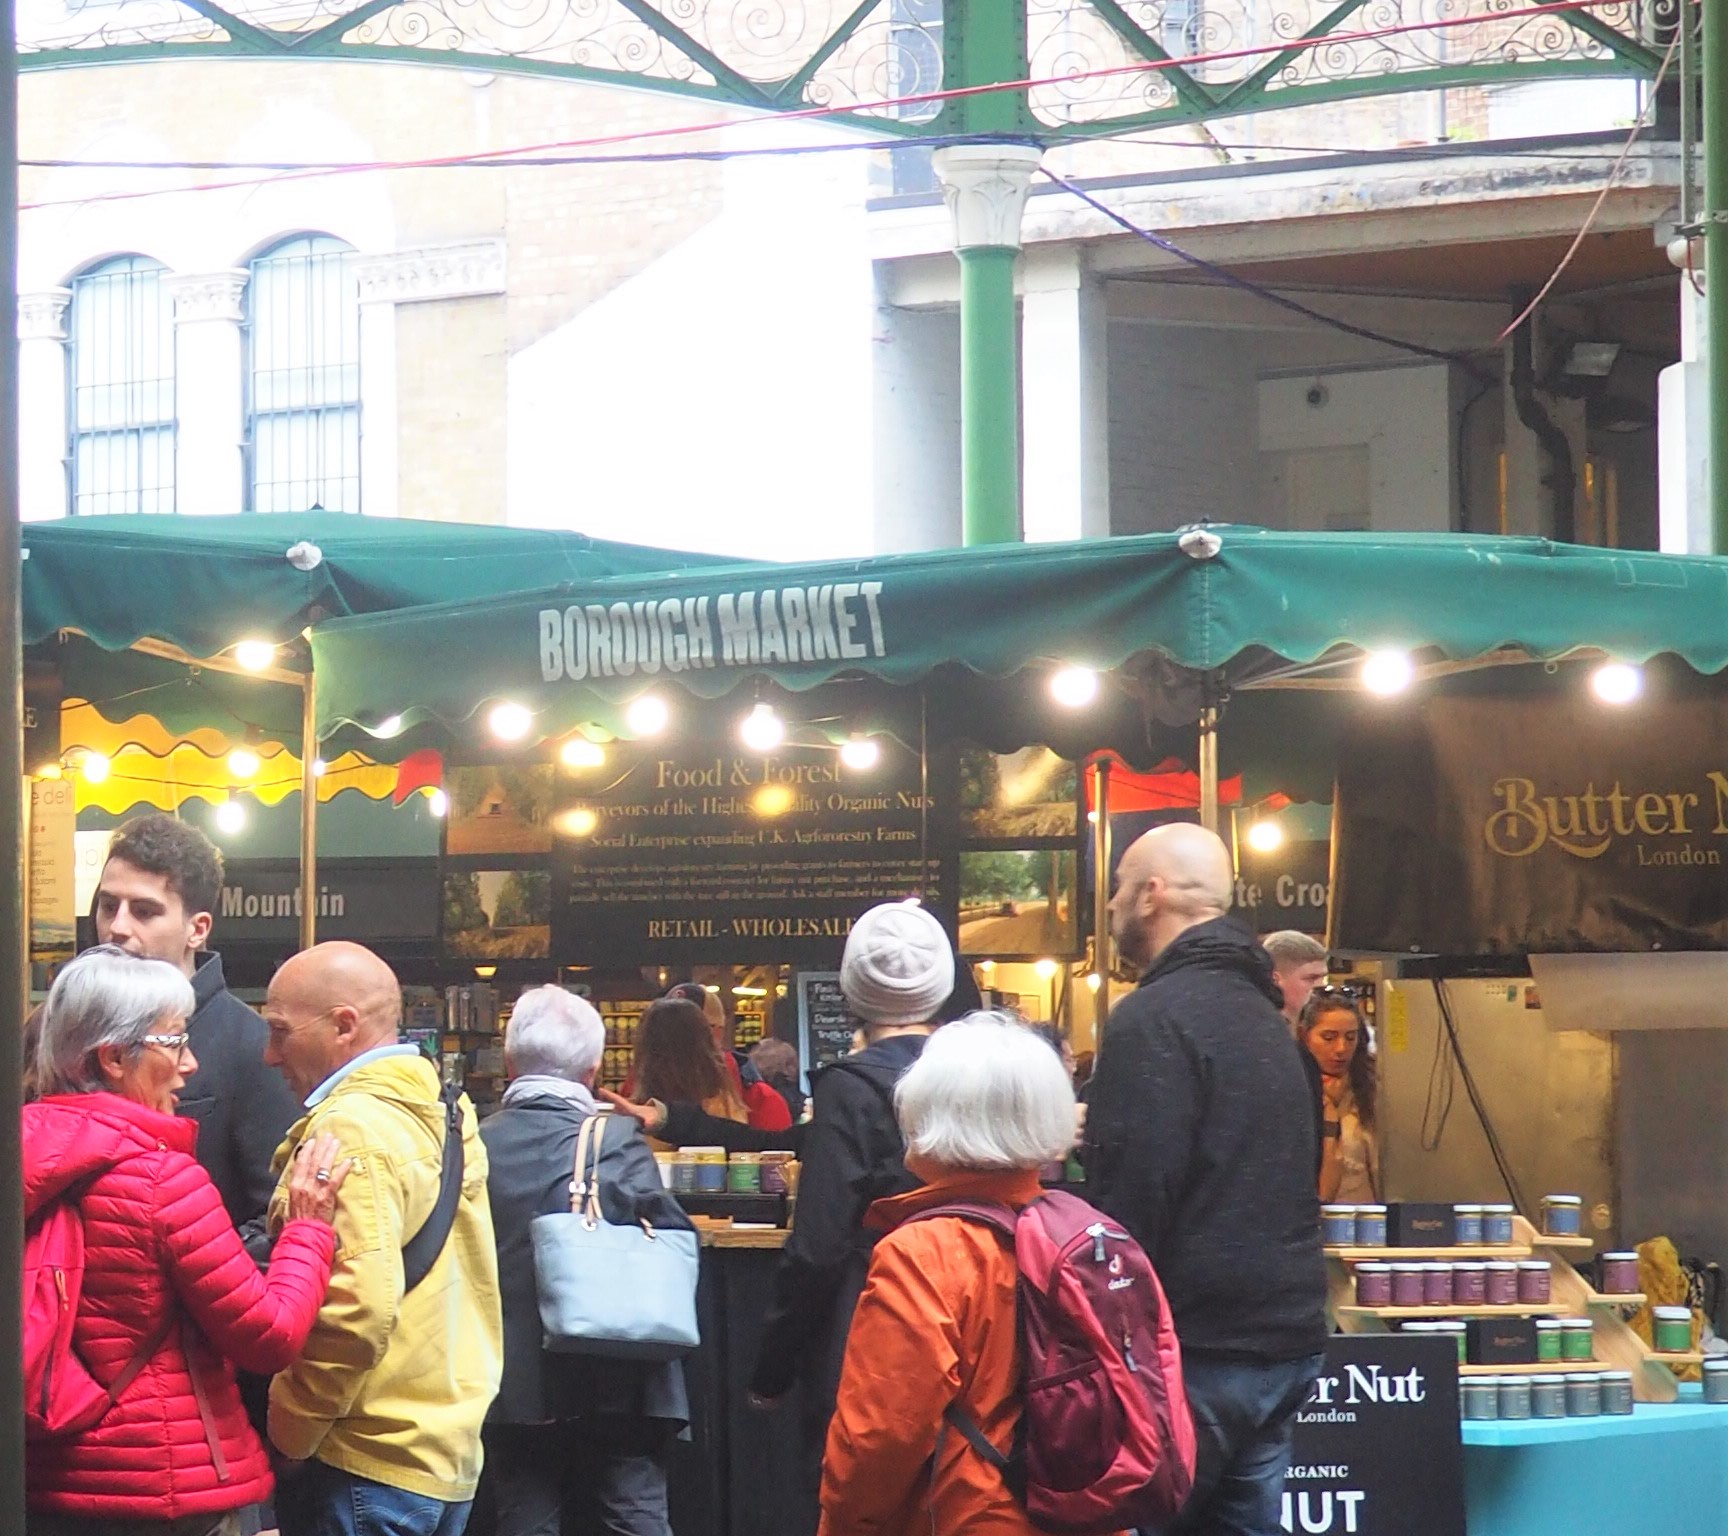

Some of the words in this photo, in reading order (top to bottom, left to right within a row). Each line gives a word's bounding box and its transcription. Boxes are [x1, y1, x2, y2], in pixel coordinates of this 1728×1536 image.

[538, 594, 716, 683] BOROUGH
[717, 581, 887, 667] MARKET
[655, 758, 723, 789] Food
[729, 757, 752, 786] &
[761, 755, 841, 785] Forest
[653, 797, 670, 816] of
[673, 797, 697, 815] the
[702, 795, 756, 817] Highes
[827, 792, 892, 813] Organic
[896, 790, 935, 810] Nus
[1484, 777, 1699, 859] Butter
[876, 826, 916, 842] Farms
[1637, 843, 1721, 866] London
[221, 885, 345, 918] Mountin
[648, 920, 719, 939] RETAIL
[732, 918, 857, 937] WHOLESALE
[1343, 1363, 1426, 1405] Nut
